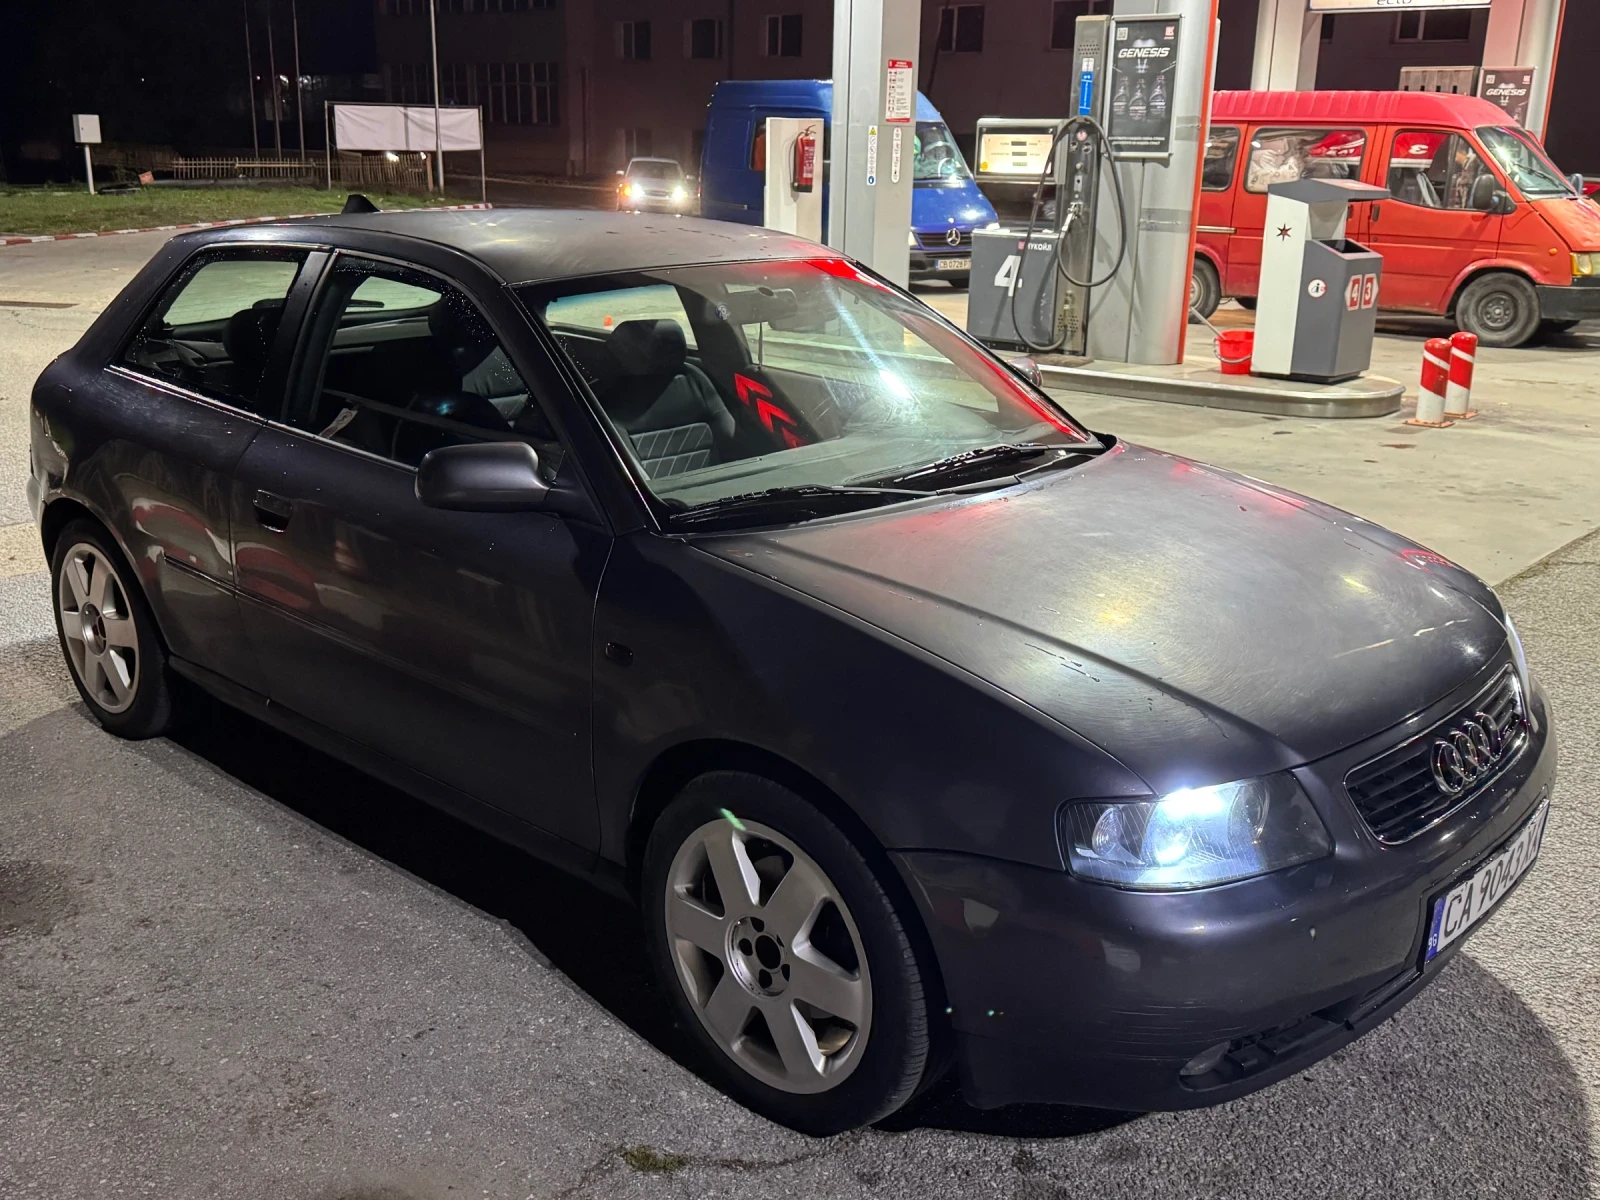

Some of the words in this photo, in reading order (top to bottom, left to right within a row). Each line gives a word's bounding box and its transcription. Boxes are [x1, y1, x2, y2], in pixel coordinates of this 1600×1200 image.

[1118, 47, 1170, 58] GENESIS
[1485, 88, 1527, 96] GENESIS
[994, 254, 1023, 297] 4
[1352, 283, 1359, 301] 4
[1364, 281, 1372, 301] 3
[1444, 881, 1474, 938] CA
[1477, 841, 1525, 913] 9043
